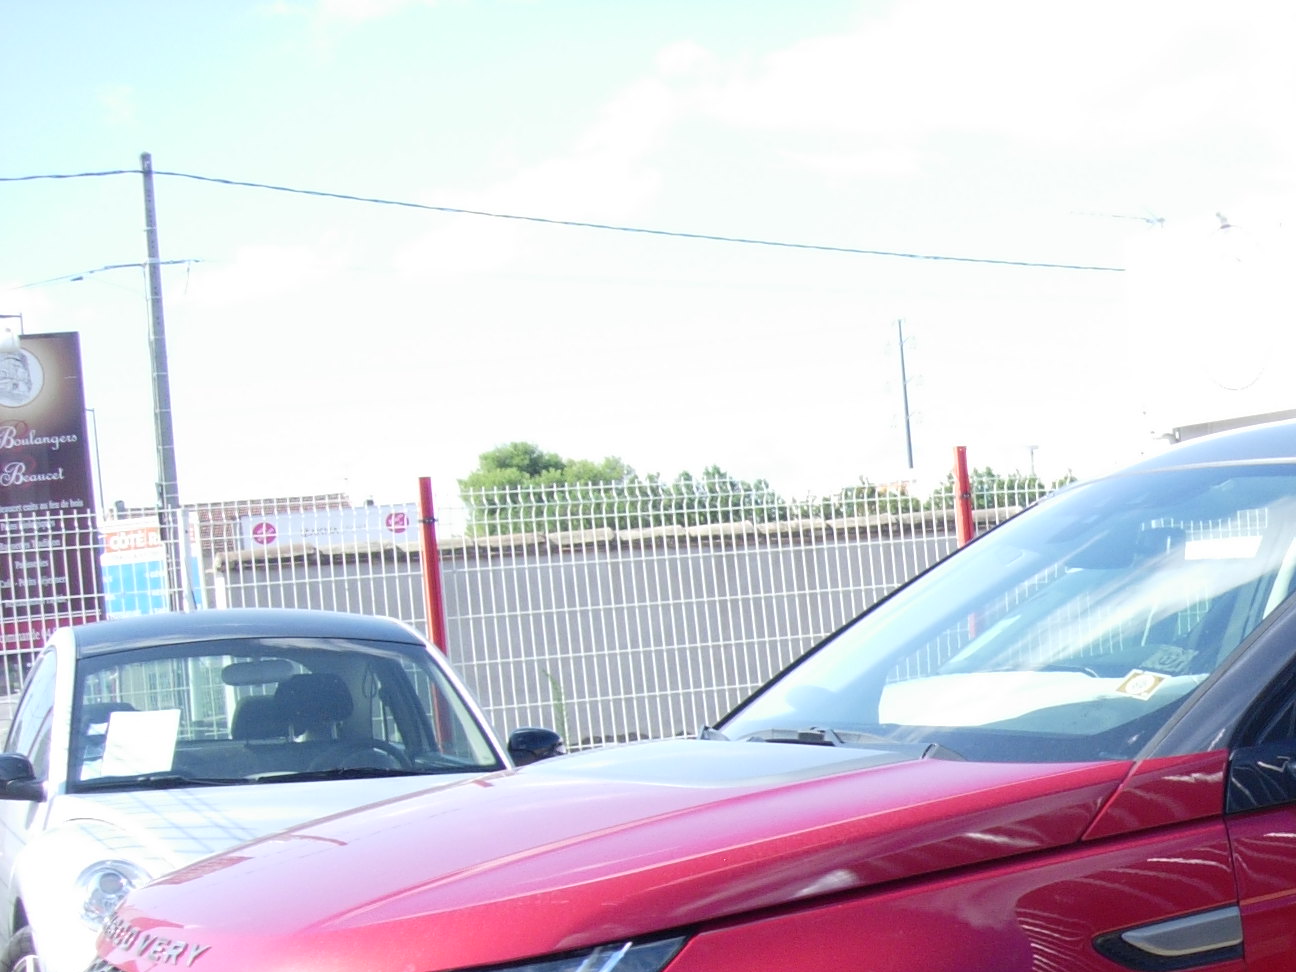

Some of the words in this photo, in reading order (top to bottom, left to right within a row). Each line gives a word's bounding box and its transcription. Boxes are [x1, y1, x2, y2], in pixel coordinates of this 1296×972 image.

[0, 425, 78, 450] Boulangers
[0, 461, 64, 487] Beaucet
[103, 911, 212, 968] SCOVERY
